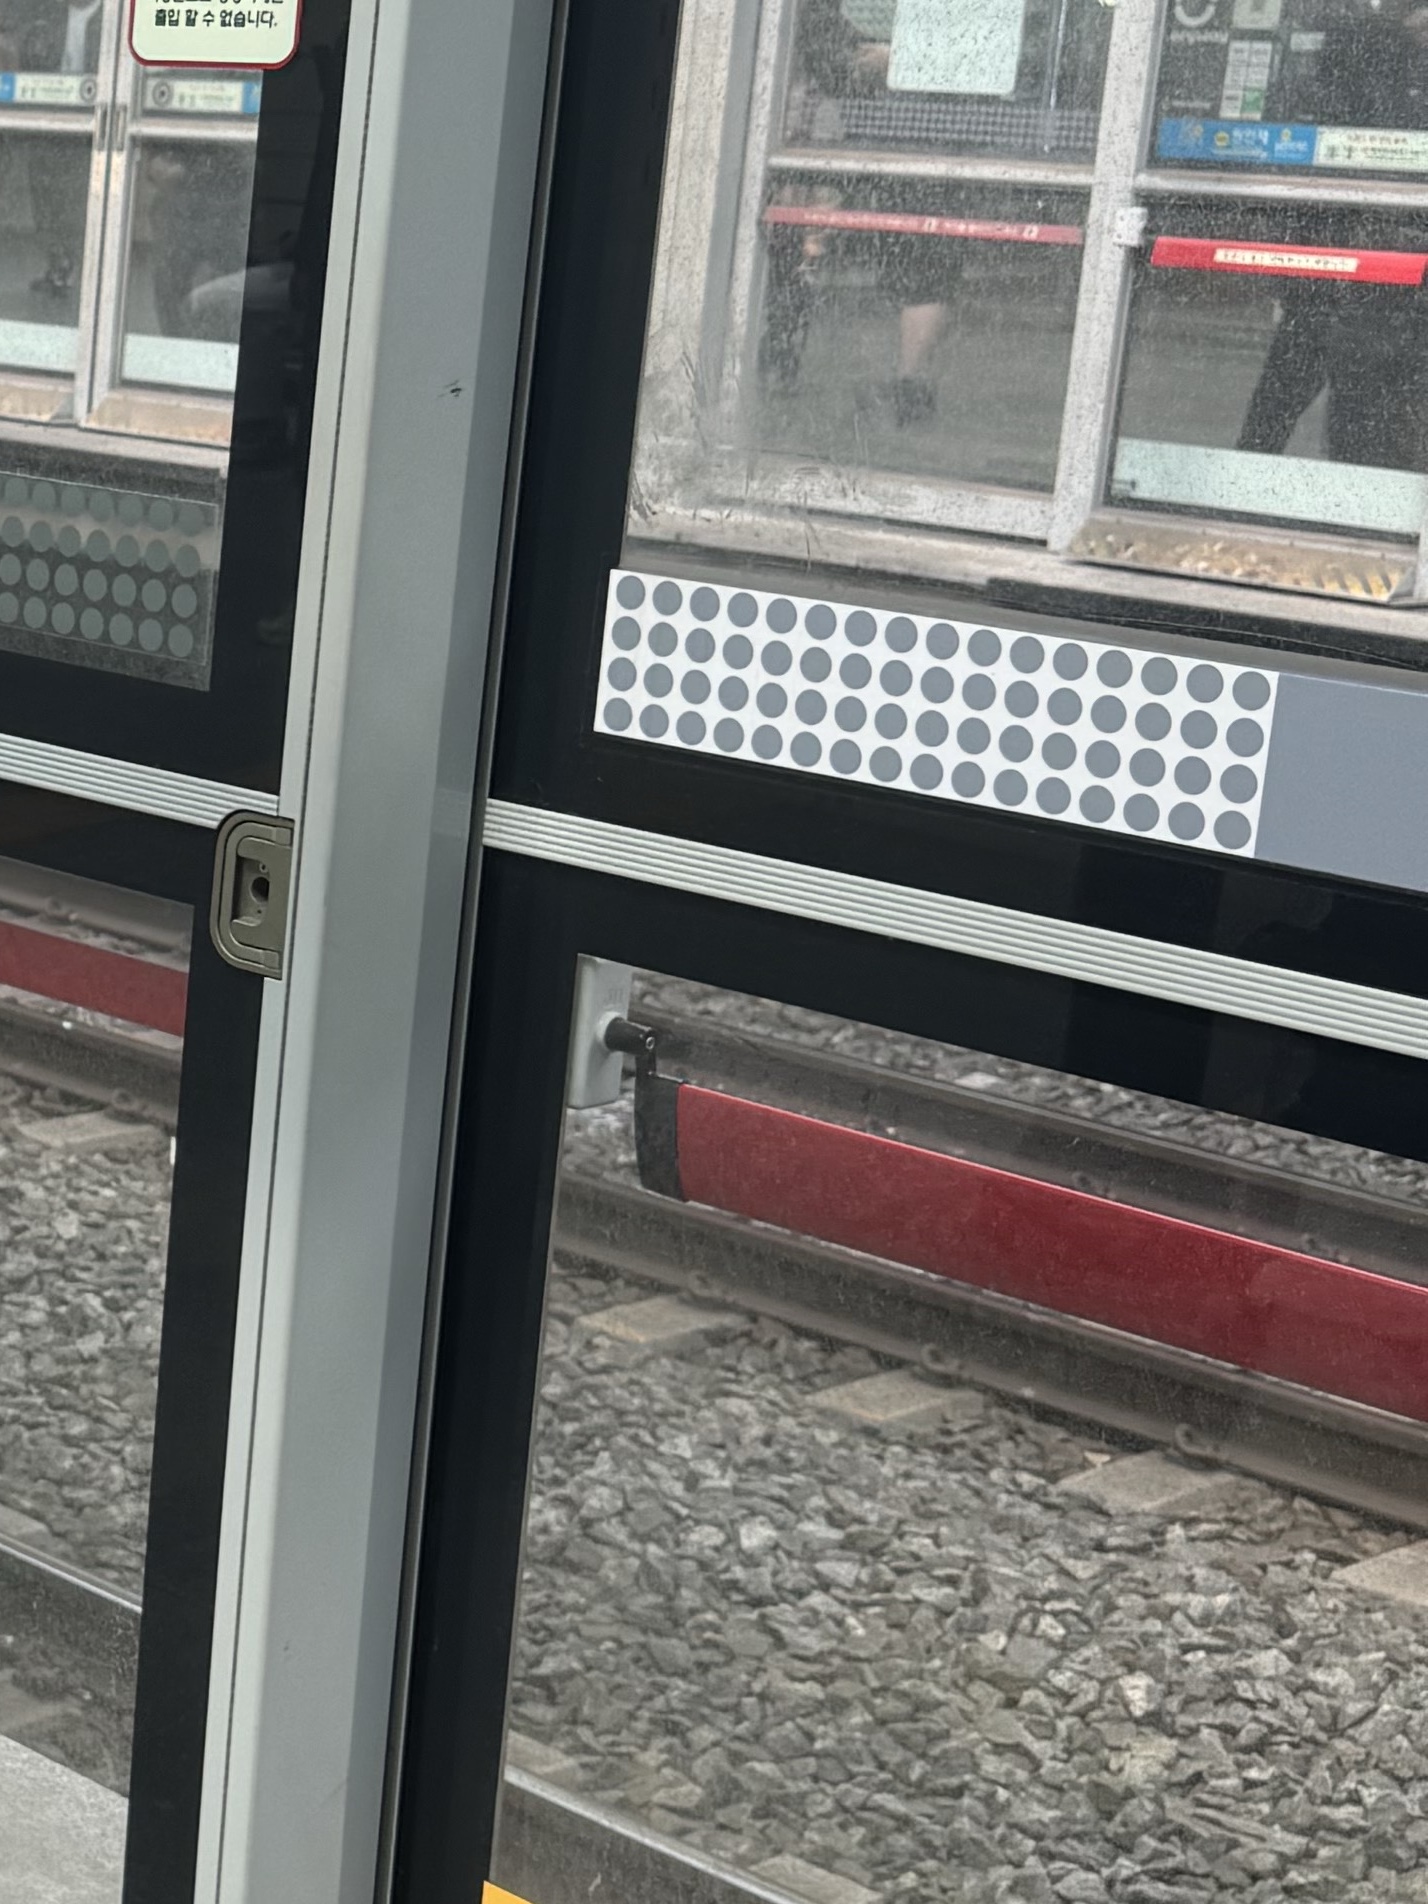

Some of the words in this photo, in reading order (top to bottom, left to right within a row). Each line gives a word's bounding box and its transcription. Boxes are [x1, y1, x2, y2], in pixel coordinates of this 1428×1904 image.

[154, 9, 180, 28] 출입
[185, 9, 199, 28] 할
[202, 10, 215, 27] 수
[219, 9, 278, 29] 없습니다.
